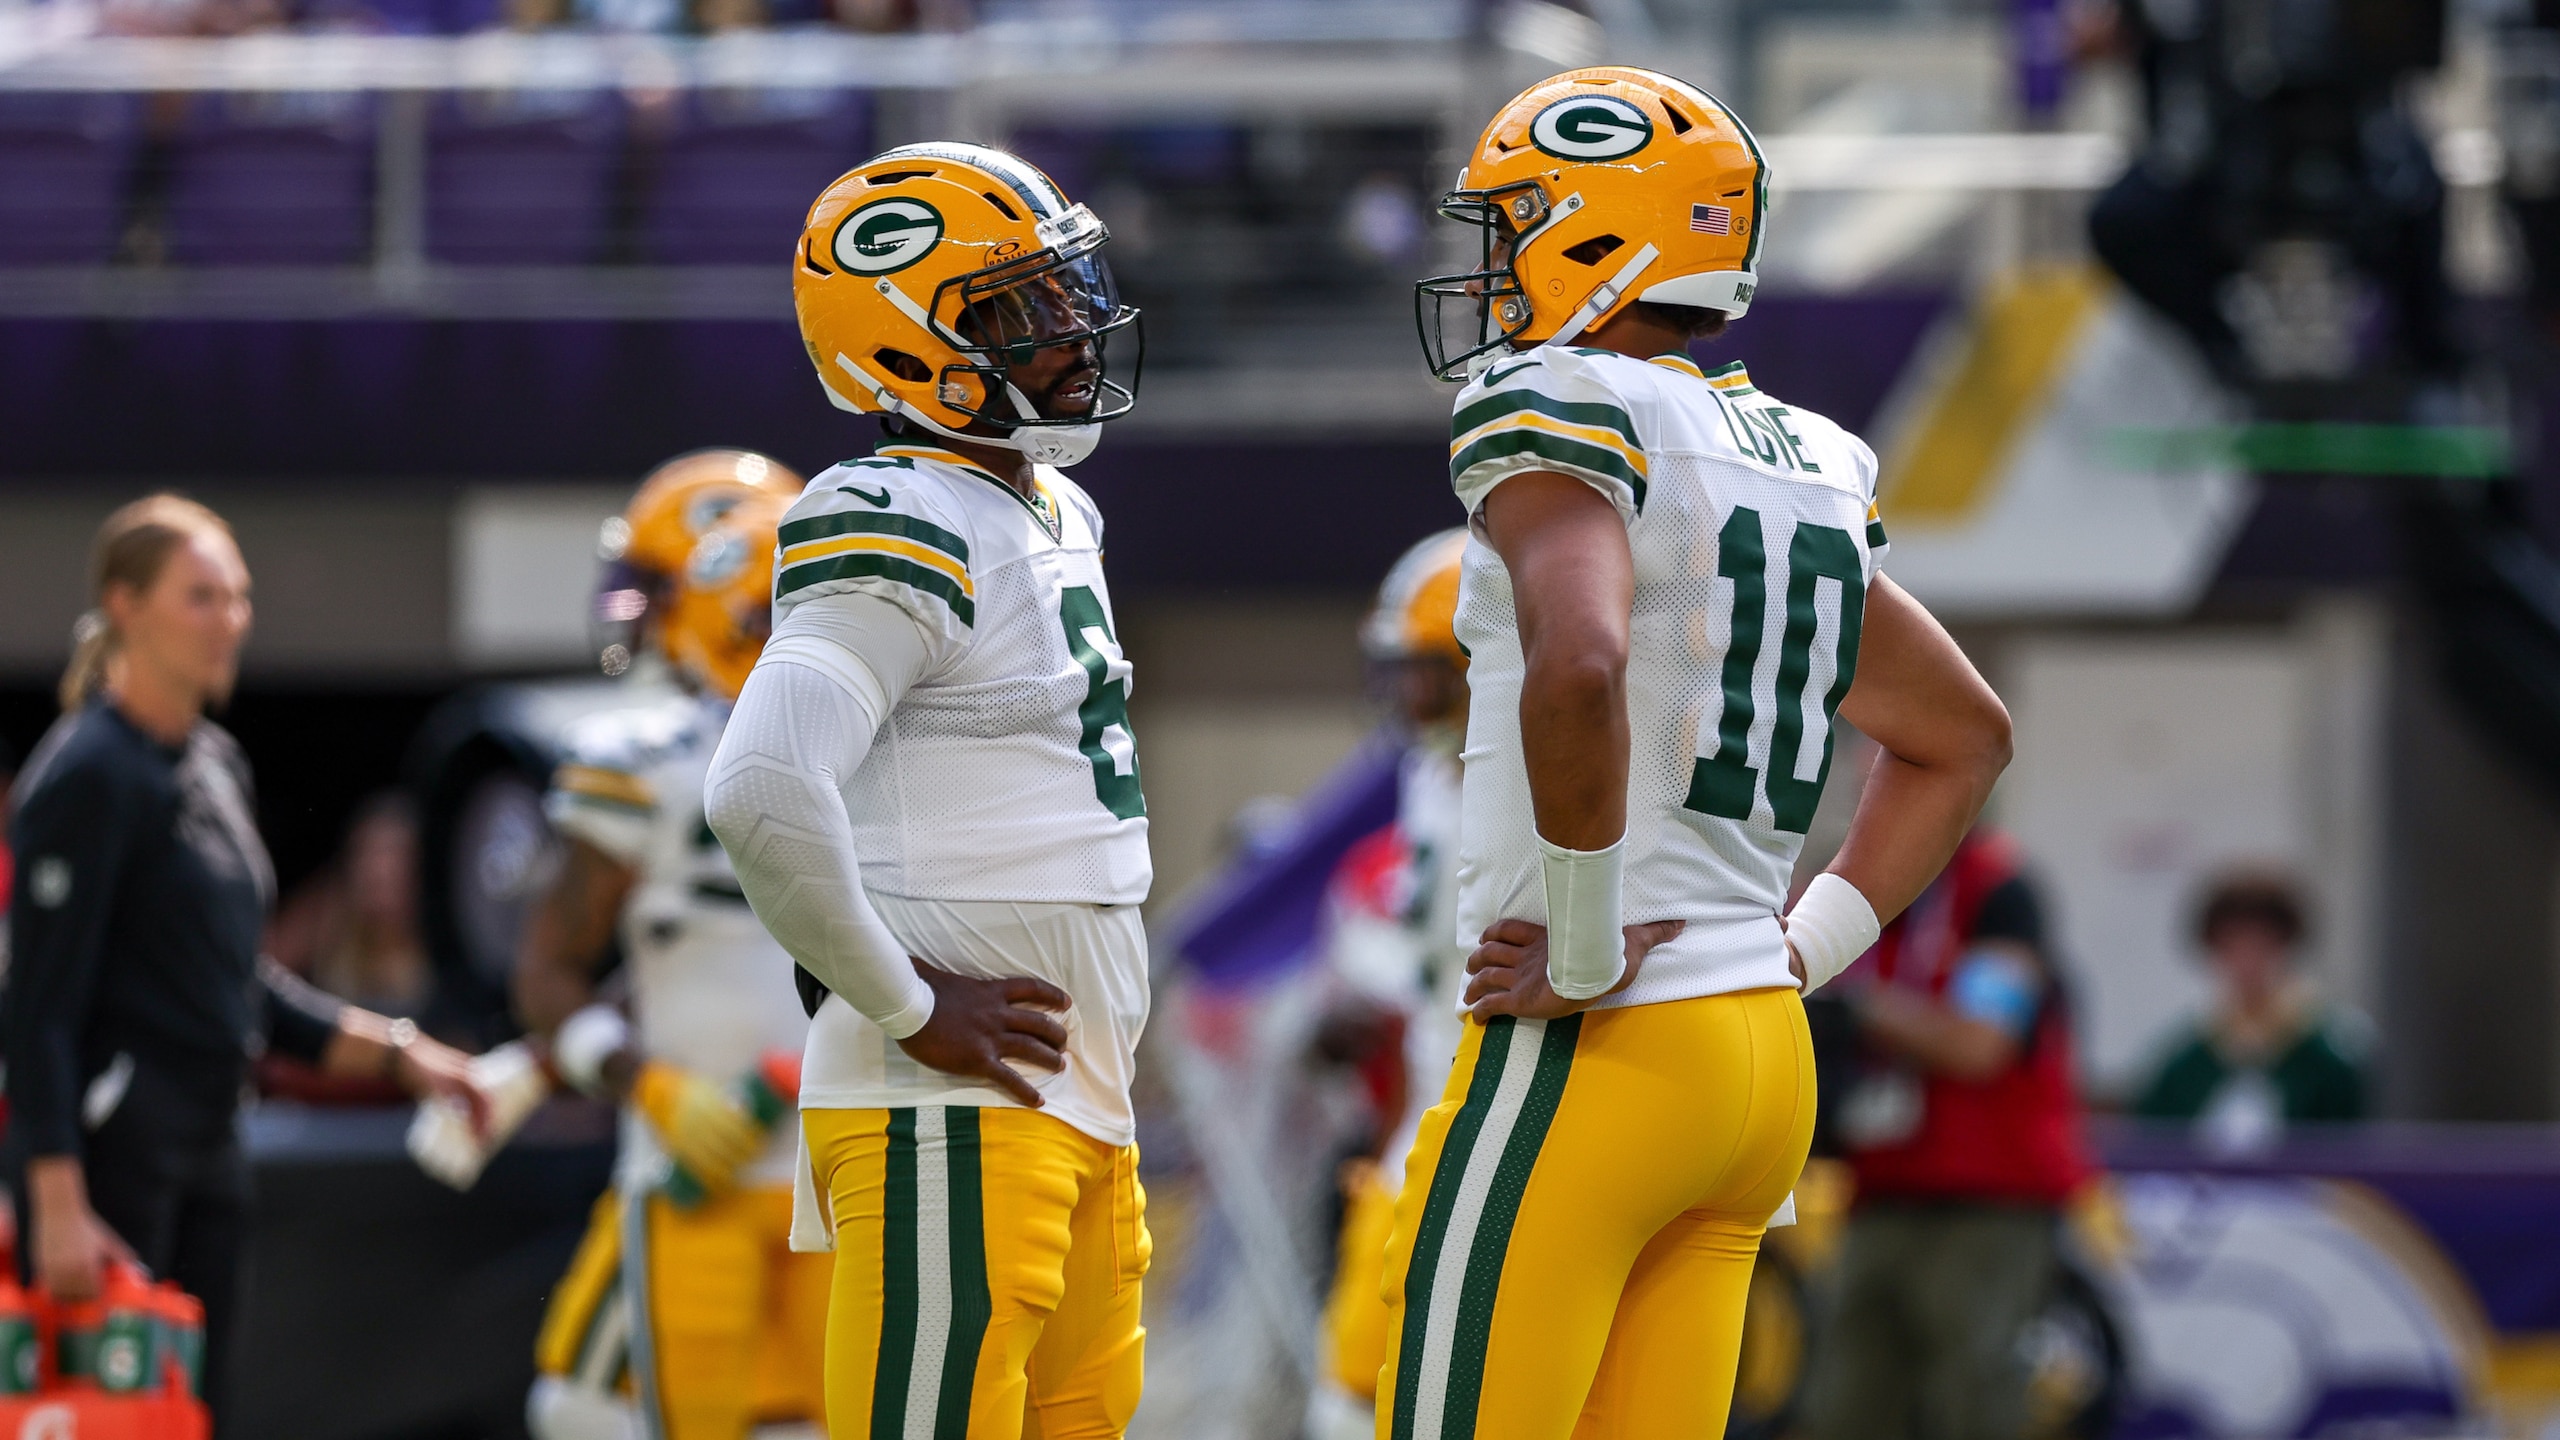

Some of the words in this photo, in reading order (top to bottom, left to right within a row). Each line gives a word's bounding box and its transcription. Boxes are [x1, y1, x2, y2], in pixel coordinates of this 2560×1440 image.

[1532, 96, 1649, 159] G
[833, 200, 942, 274] G
[1707, 390, 1822, 474] LOVE
[1061, 585, 1147, 820] 6
[1683, 505, 1864, 834] 10
